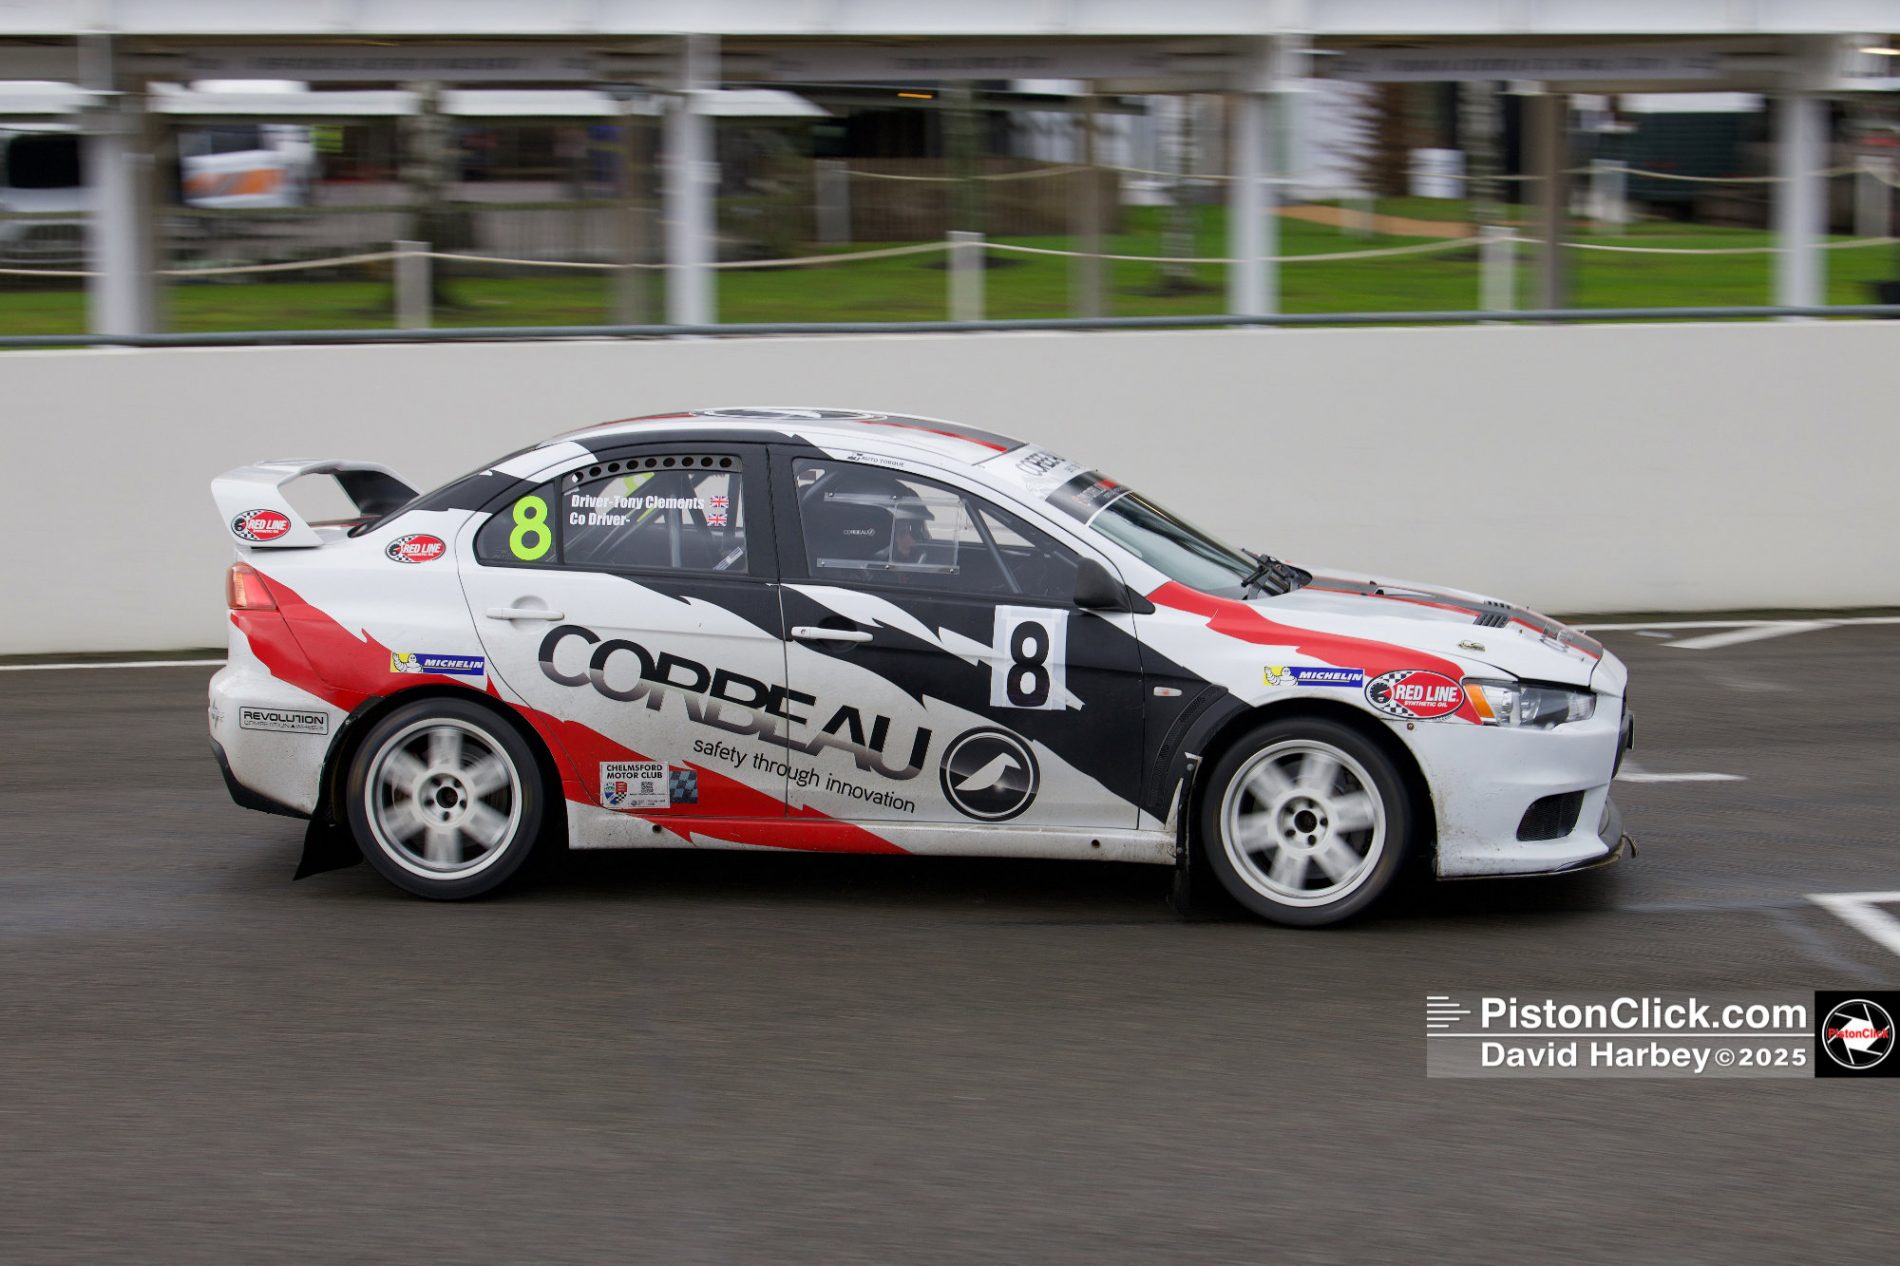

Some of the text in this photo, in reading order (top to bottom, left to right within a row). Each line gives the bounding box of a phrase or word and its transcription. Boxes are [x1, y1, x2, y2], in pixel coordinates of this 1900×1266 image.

[645, 496, 705, 510] Clements
[247, 519, 267, 530] RED
[569, 511, 631, 527] Co Driver-
[510, 495, 552, 561] 8
[402, 543, 442, 554] RED LINE
[424, 658, 484, 669] MICHELIN
[1006, 620, 1051, 707] 8
[1298, 671, 1363, 681] MICHELIN
[1395, 684, 1424, 701] RED
[538, 624, 933, 781] CORBEAU
[1404, 700, 1437, 708] SYNTHETIC
[243, 710, 325, 725] REVOLUTION
[693, 738, 916, 814] safety through innovation
